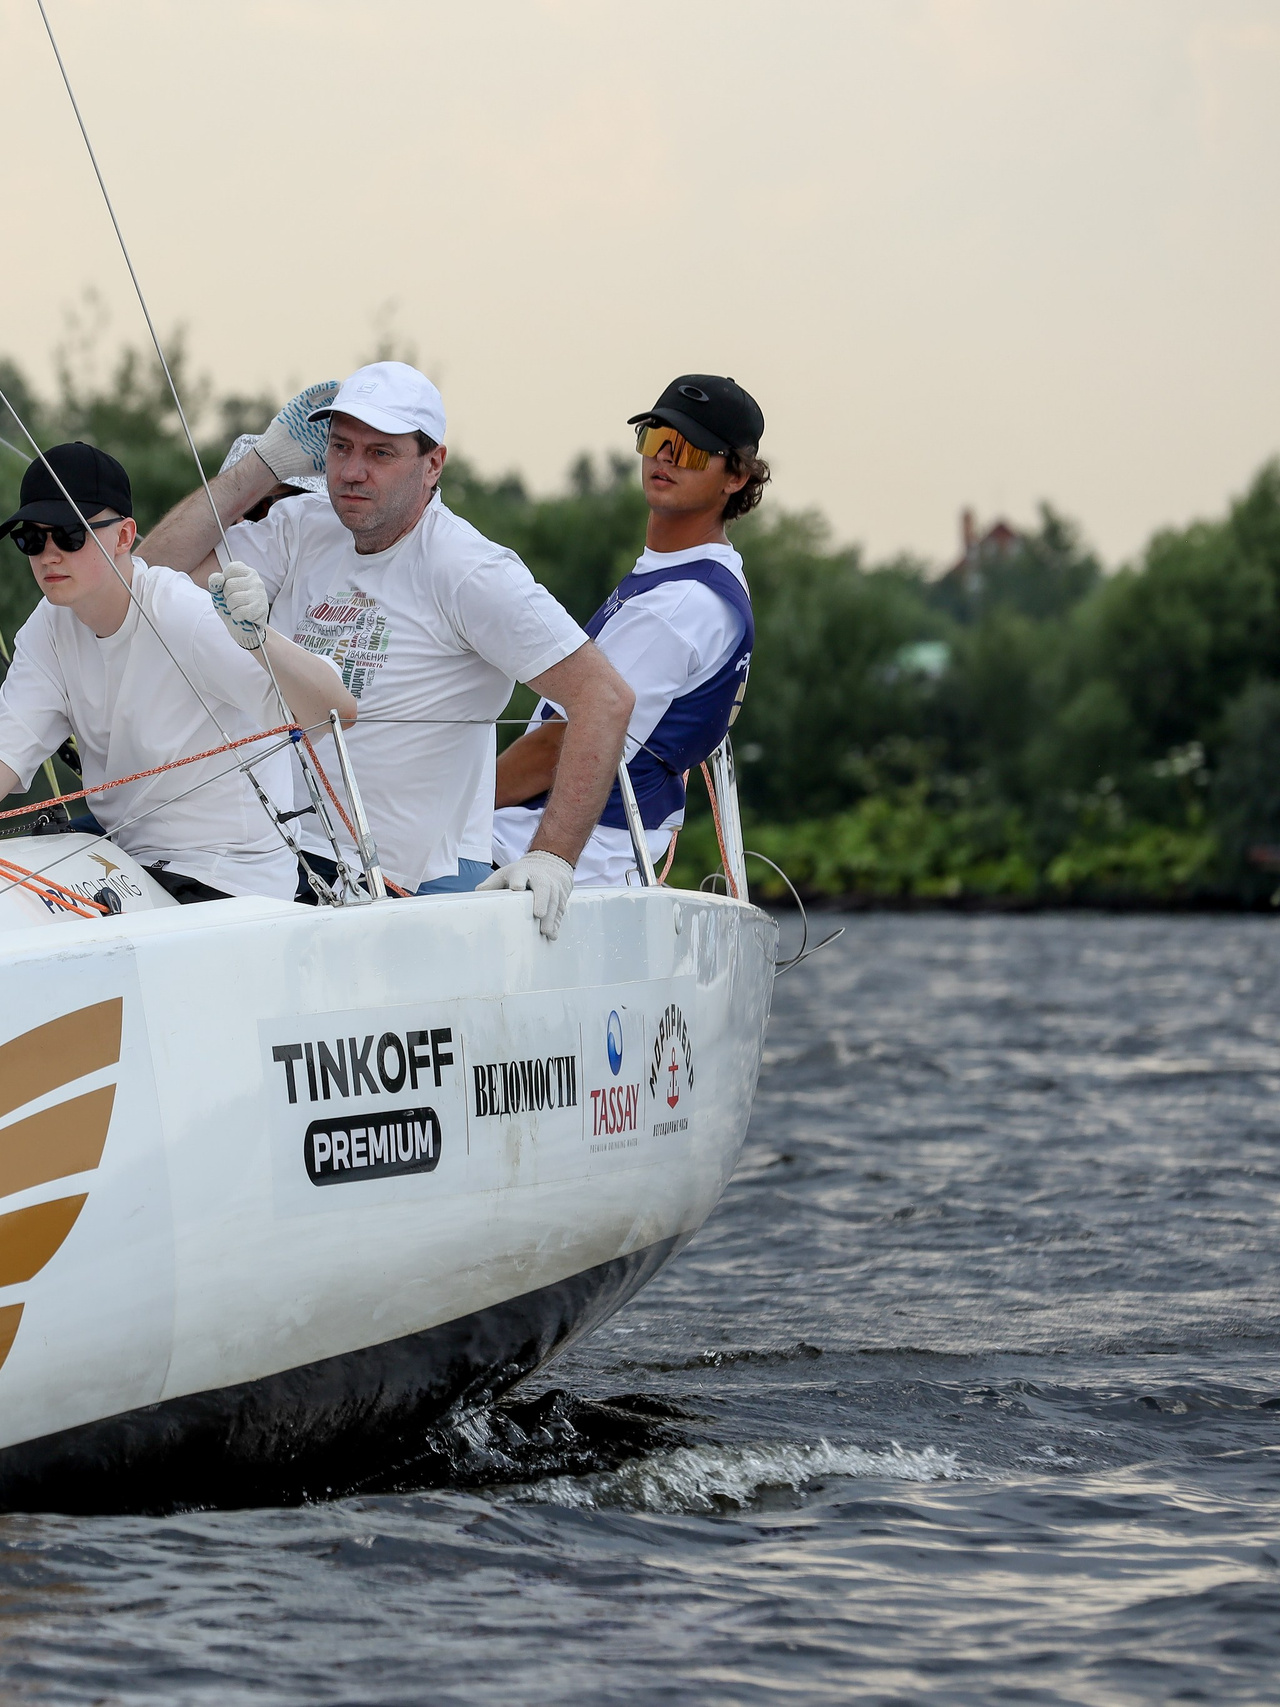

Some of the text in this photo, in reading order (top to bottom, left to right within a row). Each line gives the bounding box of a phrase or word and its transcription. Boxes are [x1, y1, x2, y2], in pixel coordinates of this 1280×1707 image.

[346, 649, 389, 663] УВАЖЕНИЕ
[368, 615, 388, 651] ВМЕСТЕ
[271, 1027, 454, 1104] TINKOFF
[472, 1055, 578, 1118] ВЕДОМОСТИ
[590, 1083, 640, 1137] TASSAY
[312, 1119, 434, 1173] PREMIUM
